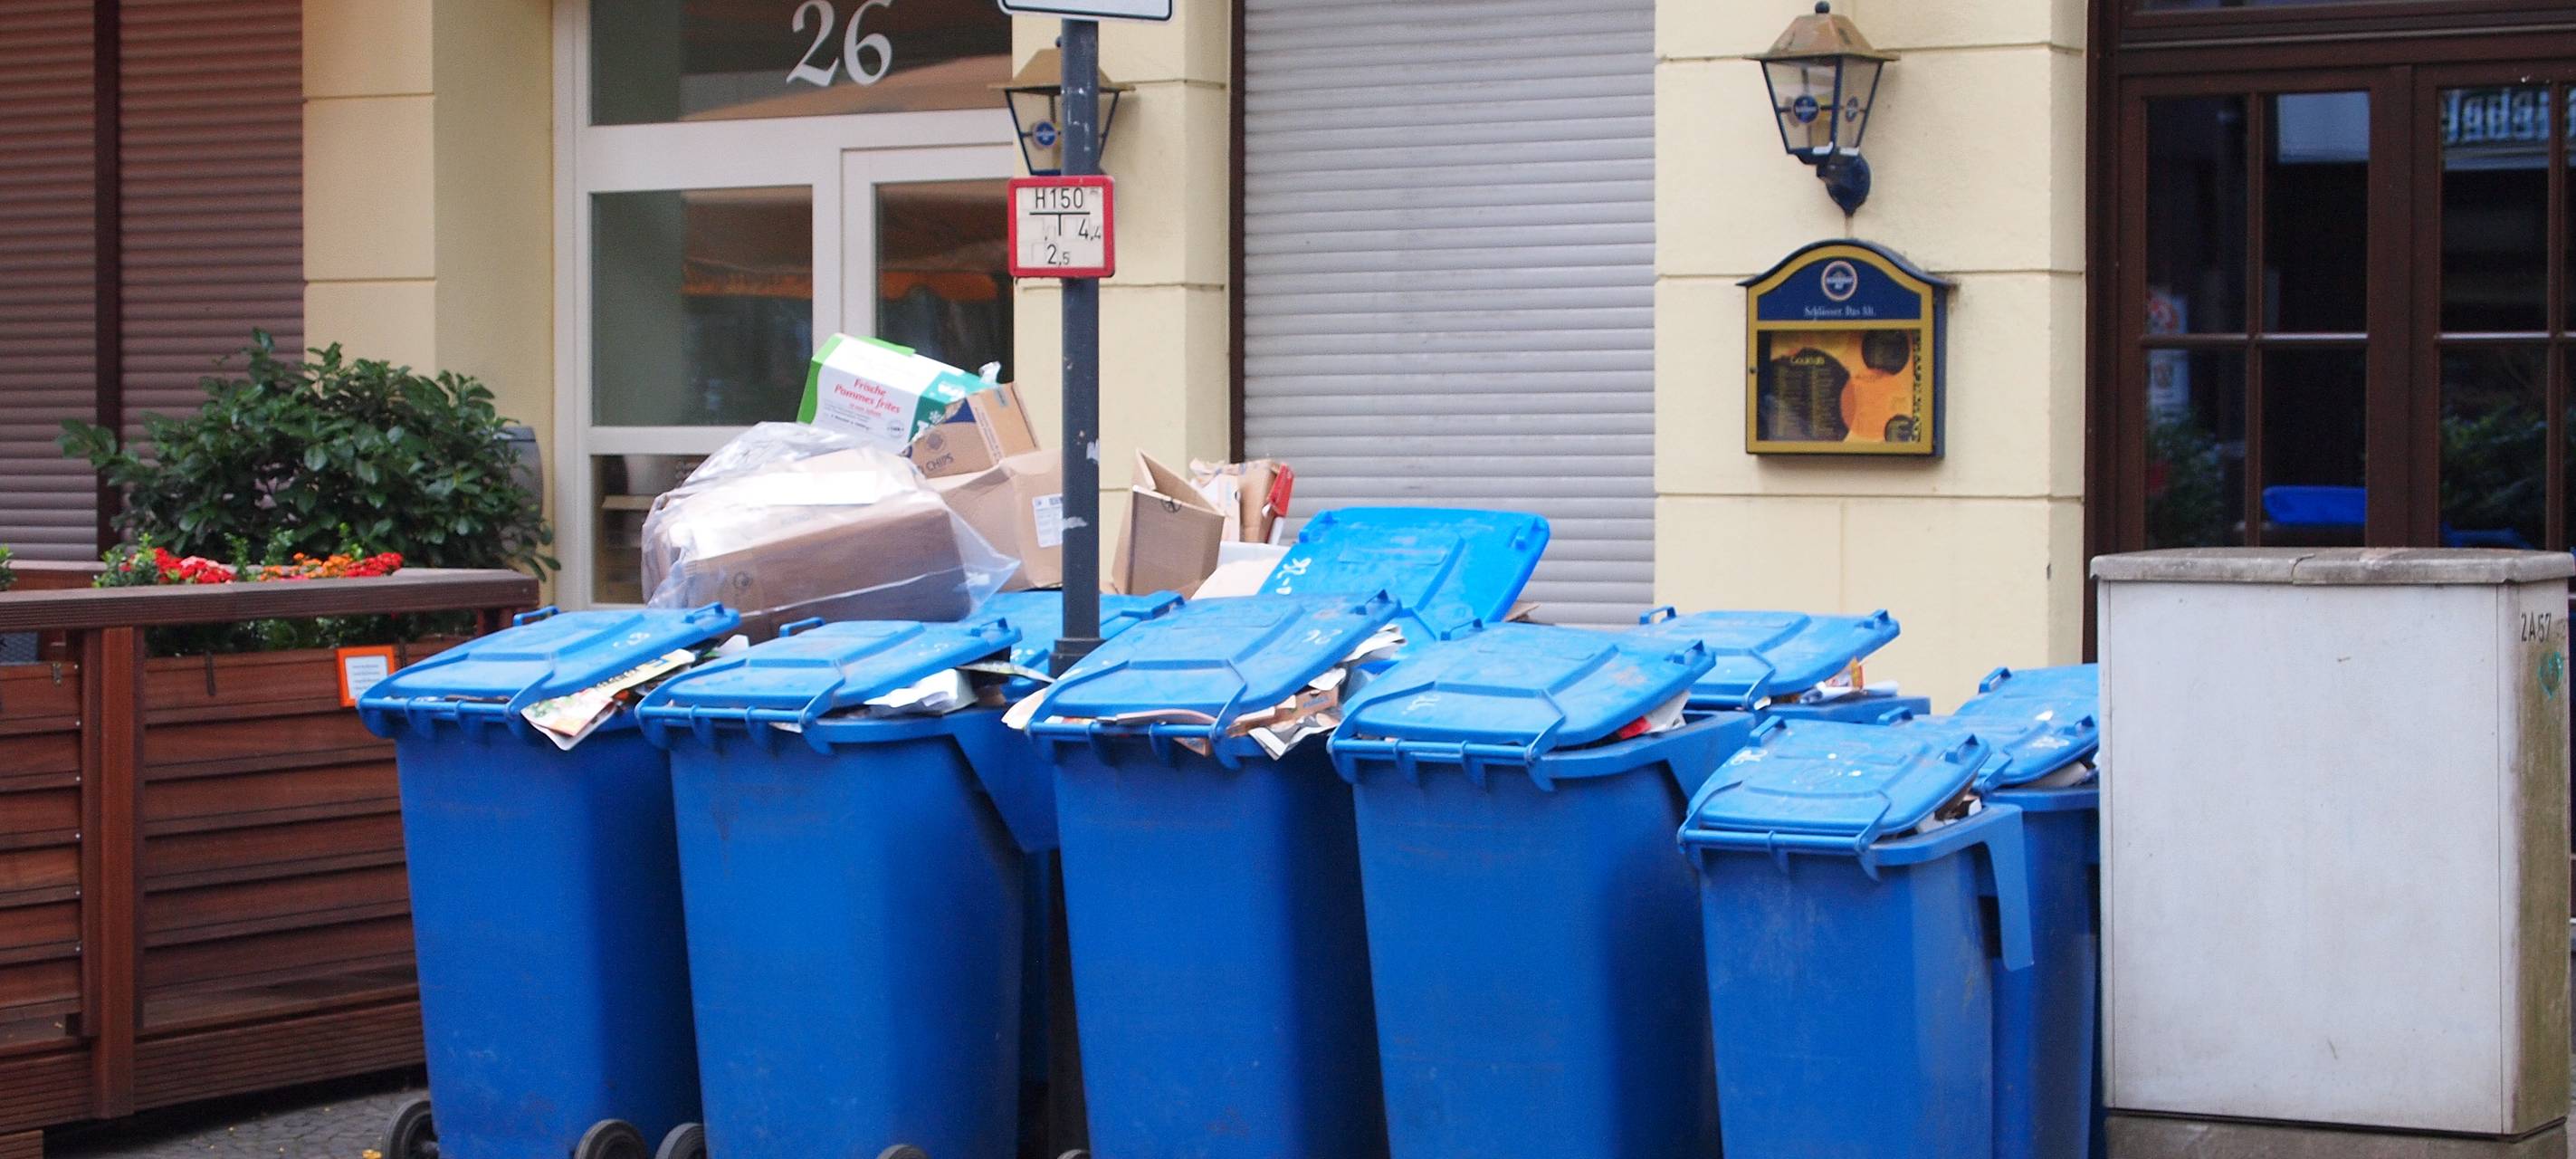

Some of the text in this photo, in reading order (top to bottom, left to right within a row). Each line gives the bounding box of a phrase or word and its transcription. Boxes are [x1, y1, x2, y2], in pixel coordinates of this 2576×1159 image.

[786, 0, 892, 88] 26
[1035, 187, 1084, 209] H150
[1077, 218, 1102, 241] 4,4
[1046, 243, 1071, 266] 2,5
[853, 377, 887, 397] Frische
[834, 383, 873, 406] Pommes
[875, 396, 901, 415] frites
[925, 452, 954, 472] CHIPS
[2520, 610, 2552, 644] 2A57
